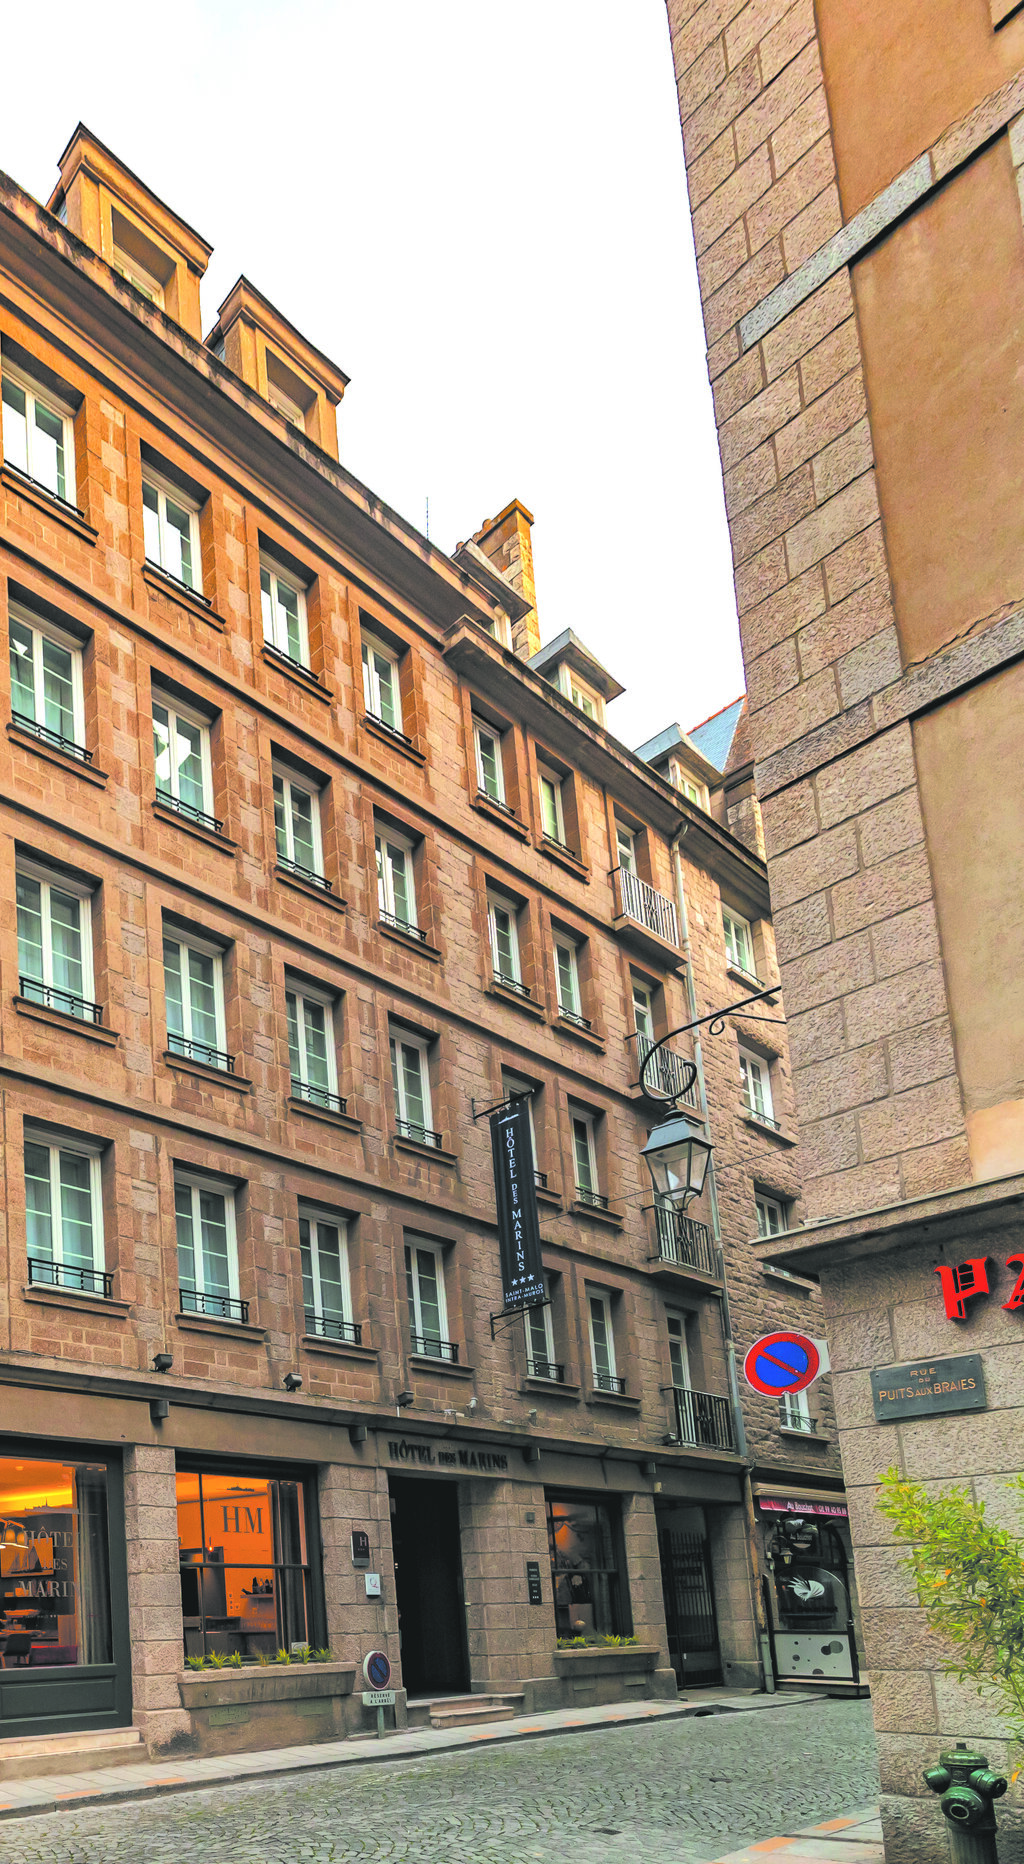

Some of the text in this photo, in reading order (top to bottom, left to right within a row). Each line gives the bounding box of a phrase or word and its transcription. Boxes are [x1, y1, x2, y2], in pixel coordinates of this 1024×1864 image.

[505, 1127, 526, 1272] HÔTEL DES MARINS
[505, 1283, 543, 1298] SAINT-MALO
[506, 1289, 544, 1303] INTRA-MUROS
[910, 1367, 937, 1377] RUE
[879, 1378, 976, 1402] PUITS AUX BRAIES
[388, 1439, 508, 1470] HÔTEL DES MARINS
[220, 1505, 264, 1534] HM
[359, 1536, 367, 1546] H
